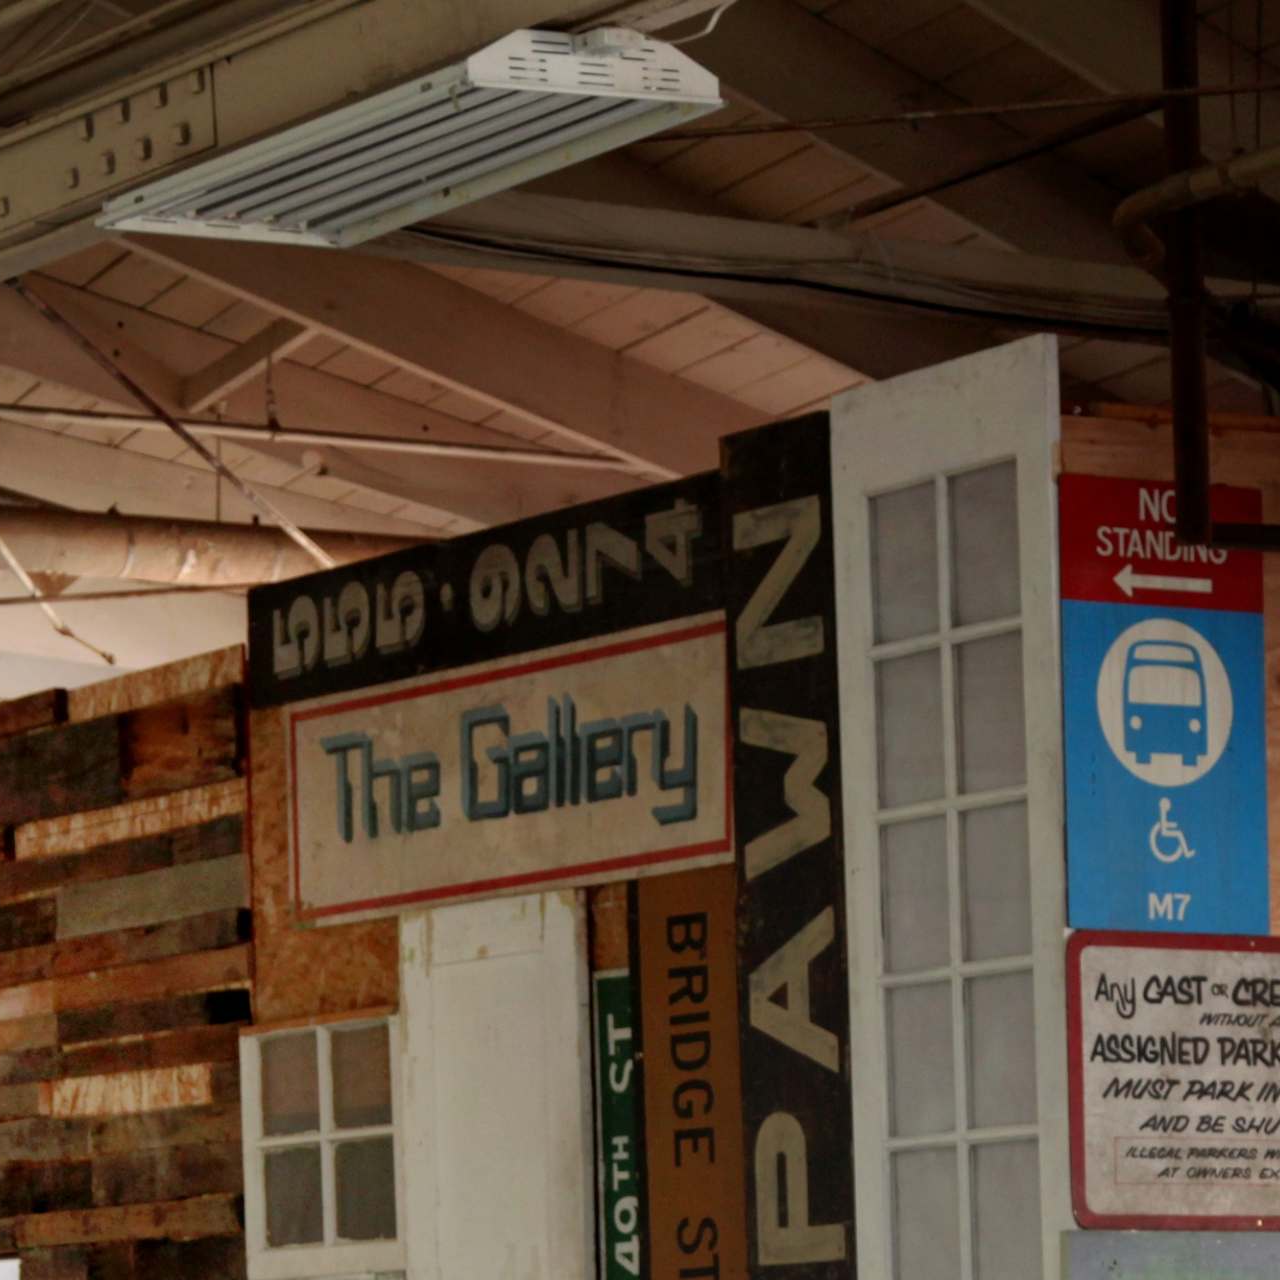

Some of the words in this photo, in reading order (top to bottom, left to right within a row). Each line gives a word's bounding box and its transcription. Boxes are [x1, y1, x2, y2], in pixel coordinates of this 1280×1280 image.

[321, 731, 442, 844] The
[459, 691, 699, 826] Gallery
[732, 495, 847, 1267] PAWN
[1147, 892, 1192, 921] M7
[1094, 972, 1137, 1019] Any
[1142, 975, 1208, 1006] CAST
[1198, 1012, 1268, 1027] WITHOUT
[607, 1013, 636, 1094] ST
[665, 911, 715, 1168] BRIDGE
[1090, 1031, 1211, 1066] ASSIGNED
[1102, 1077, 1181, 1100] MUST
[1182, 1078, 1254, 1102] PARK
[1139, 1114, 1190, 1133] AND
[1195, 1115, 1226, 1134] BE
[1125, 1146, 1183, 1161] ILLEGAL
[1186, 1146, 1258, 1161] PARKERS
[1157, 1166, 1181, 1179] AT
[1186, 1167, 1253, 1180] OWNERS
